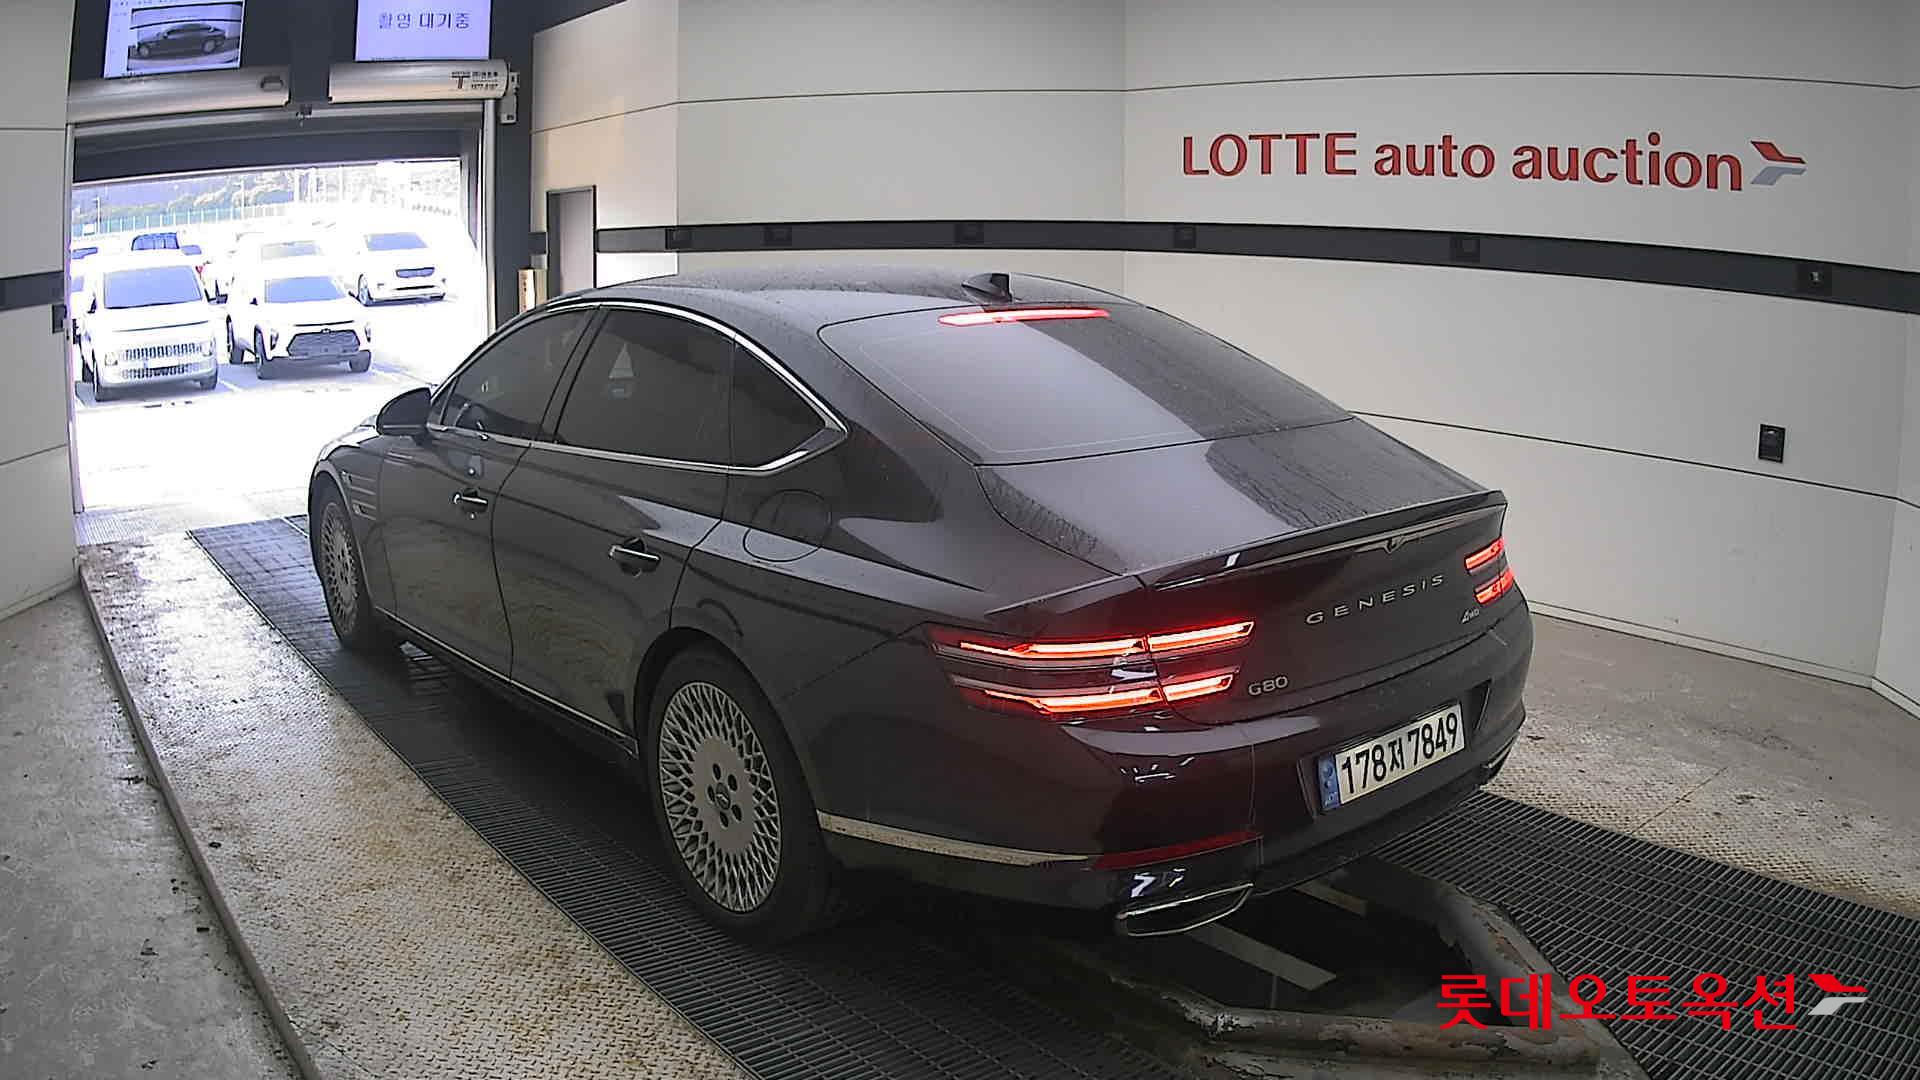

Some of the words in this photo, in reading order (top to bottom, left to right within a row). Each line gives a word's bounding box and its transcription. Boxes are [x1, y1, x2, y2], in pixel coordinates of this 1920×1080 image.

[419, 12, 470, 29] 대기중
[1182, 132, 1358, 176] LOTTE
[1374, 134, 1496, 178] auto
[1511, 132, 1744, 192] auction
[1304, 574, 1445, 625] GENESIS
[1248, 675, 1289, 696] G80
[1341, 736, 1405, 794] 178저
[1407, 712, 1459, 767] 7849
